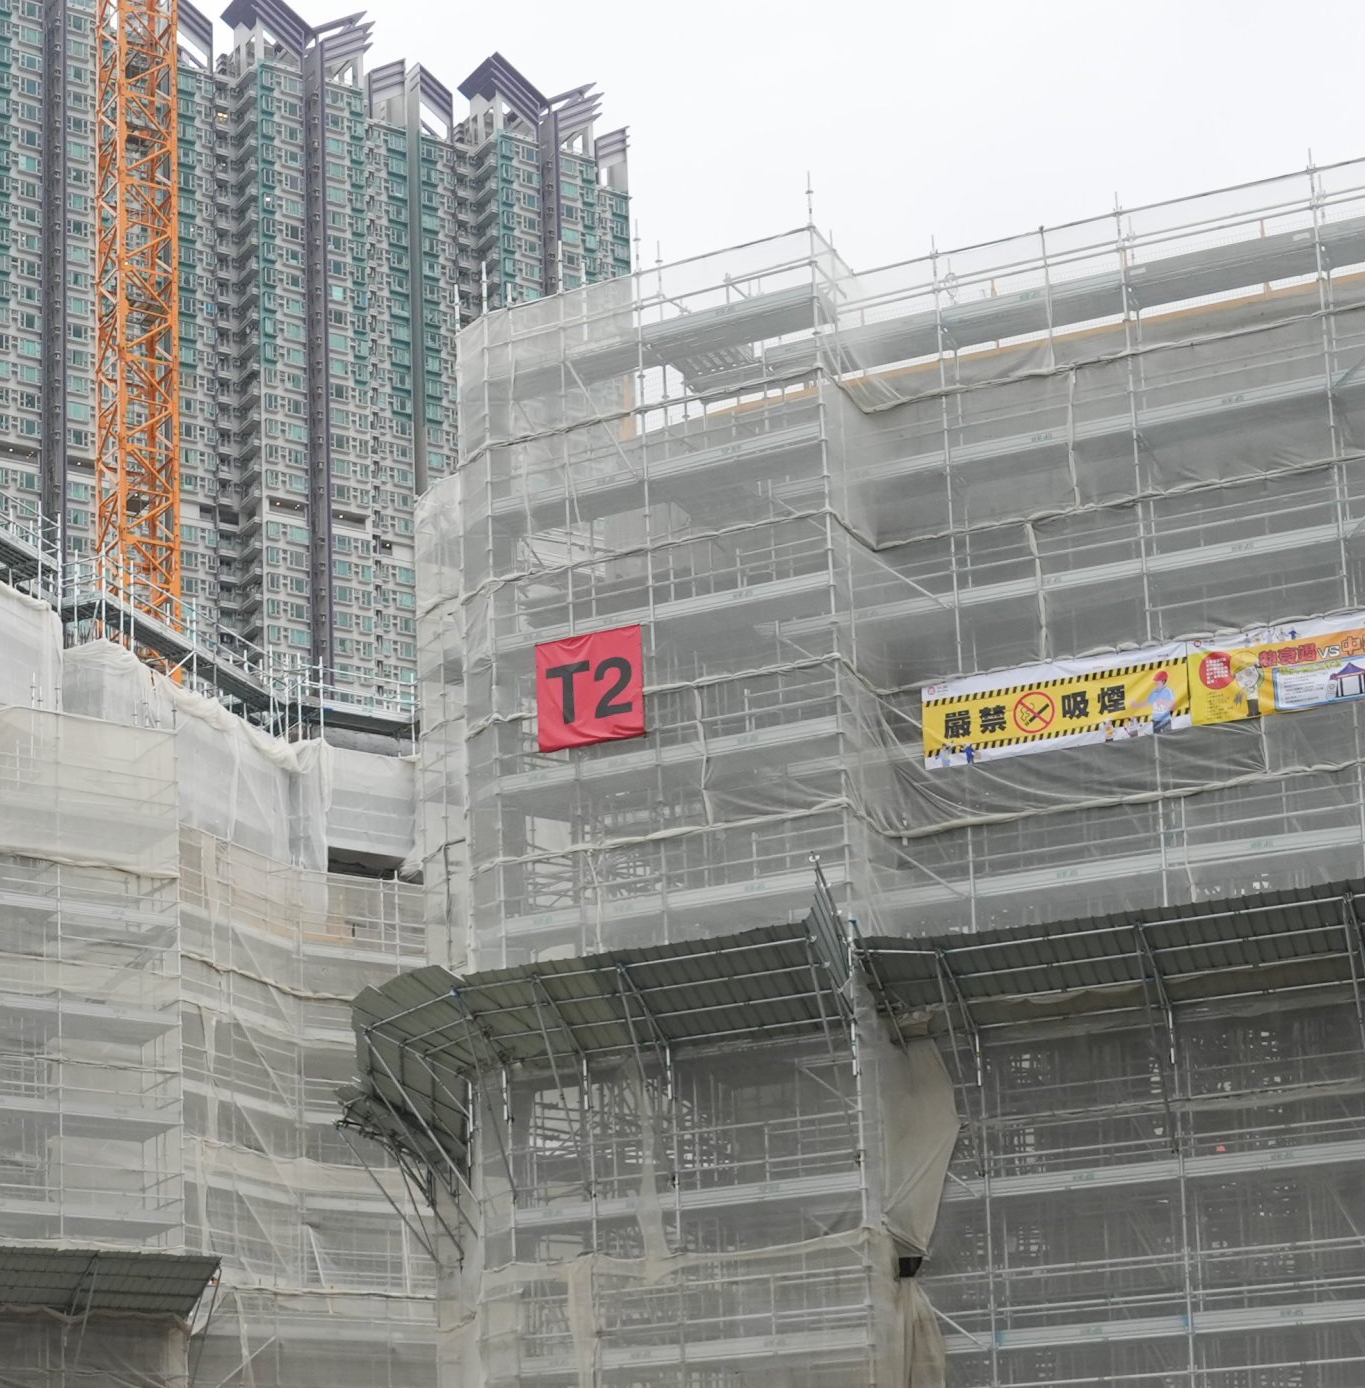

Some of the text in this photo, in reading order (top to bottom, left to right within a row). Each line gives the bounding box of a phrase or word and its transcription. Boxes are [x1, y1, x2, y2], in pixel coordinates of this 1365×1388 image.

[1317, 645, 1341, 660] VS
[546, 657, 633, 725] T2
[943, 684, 1126, 739] 嚴禁 吸煙
